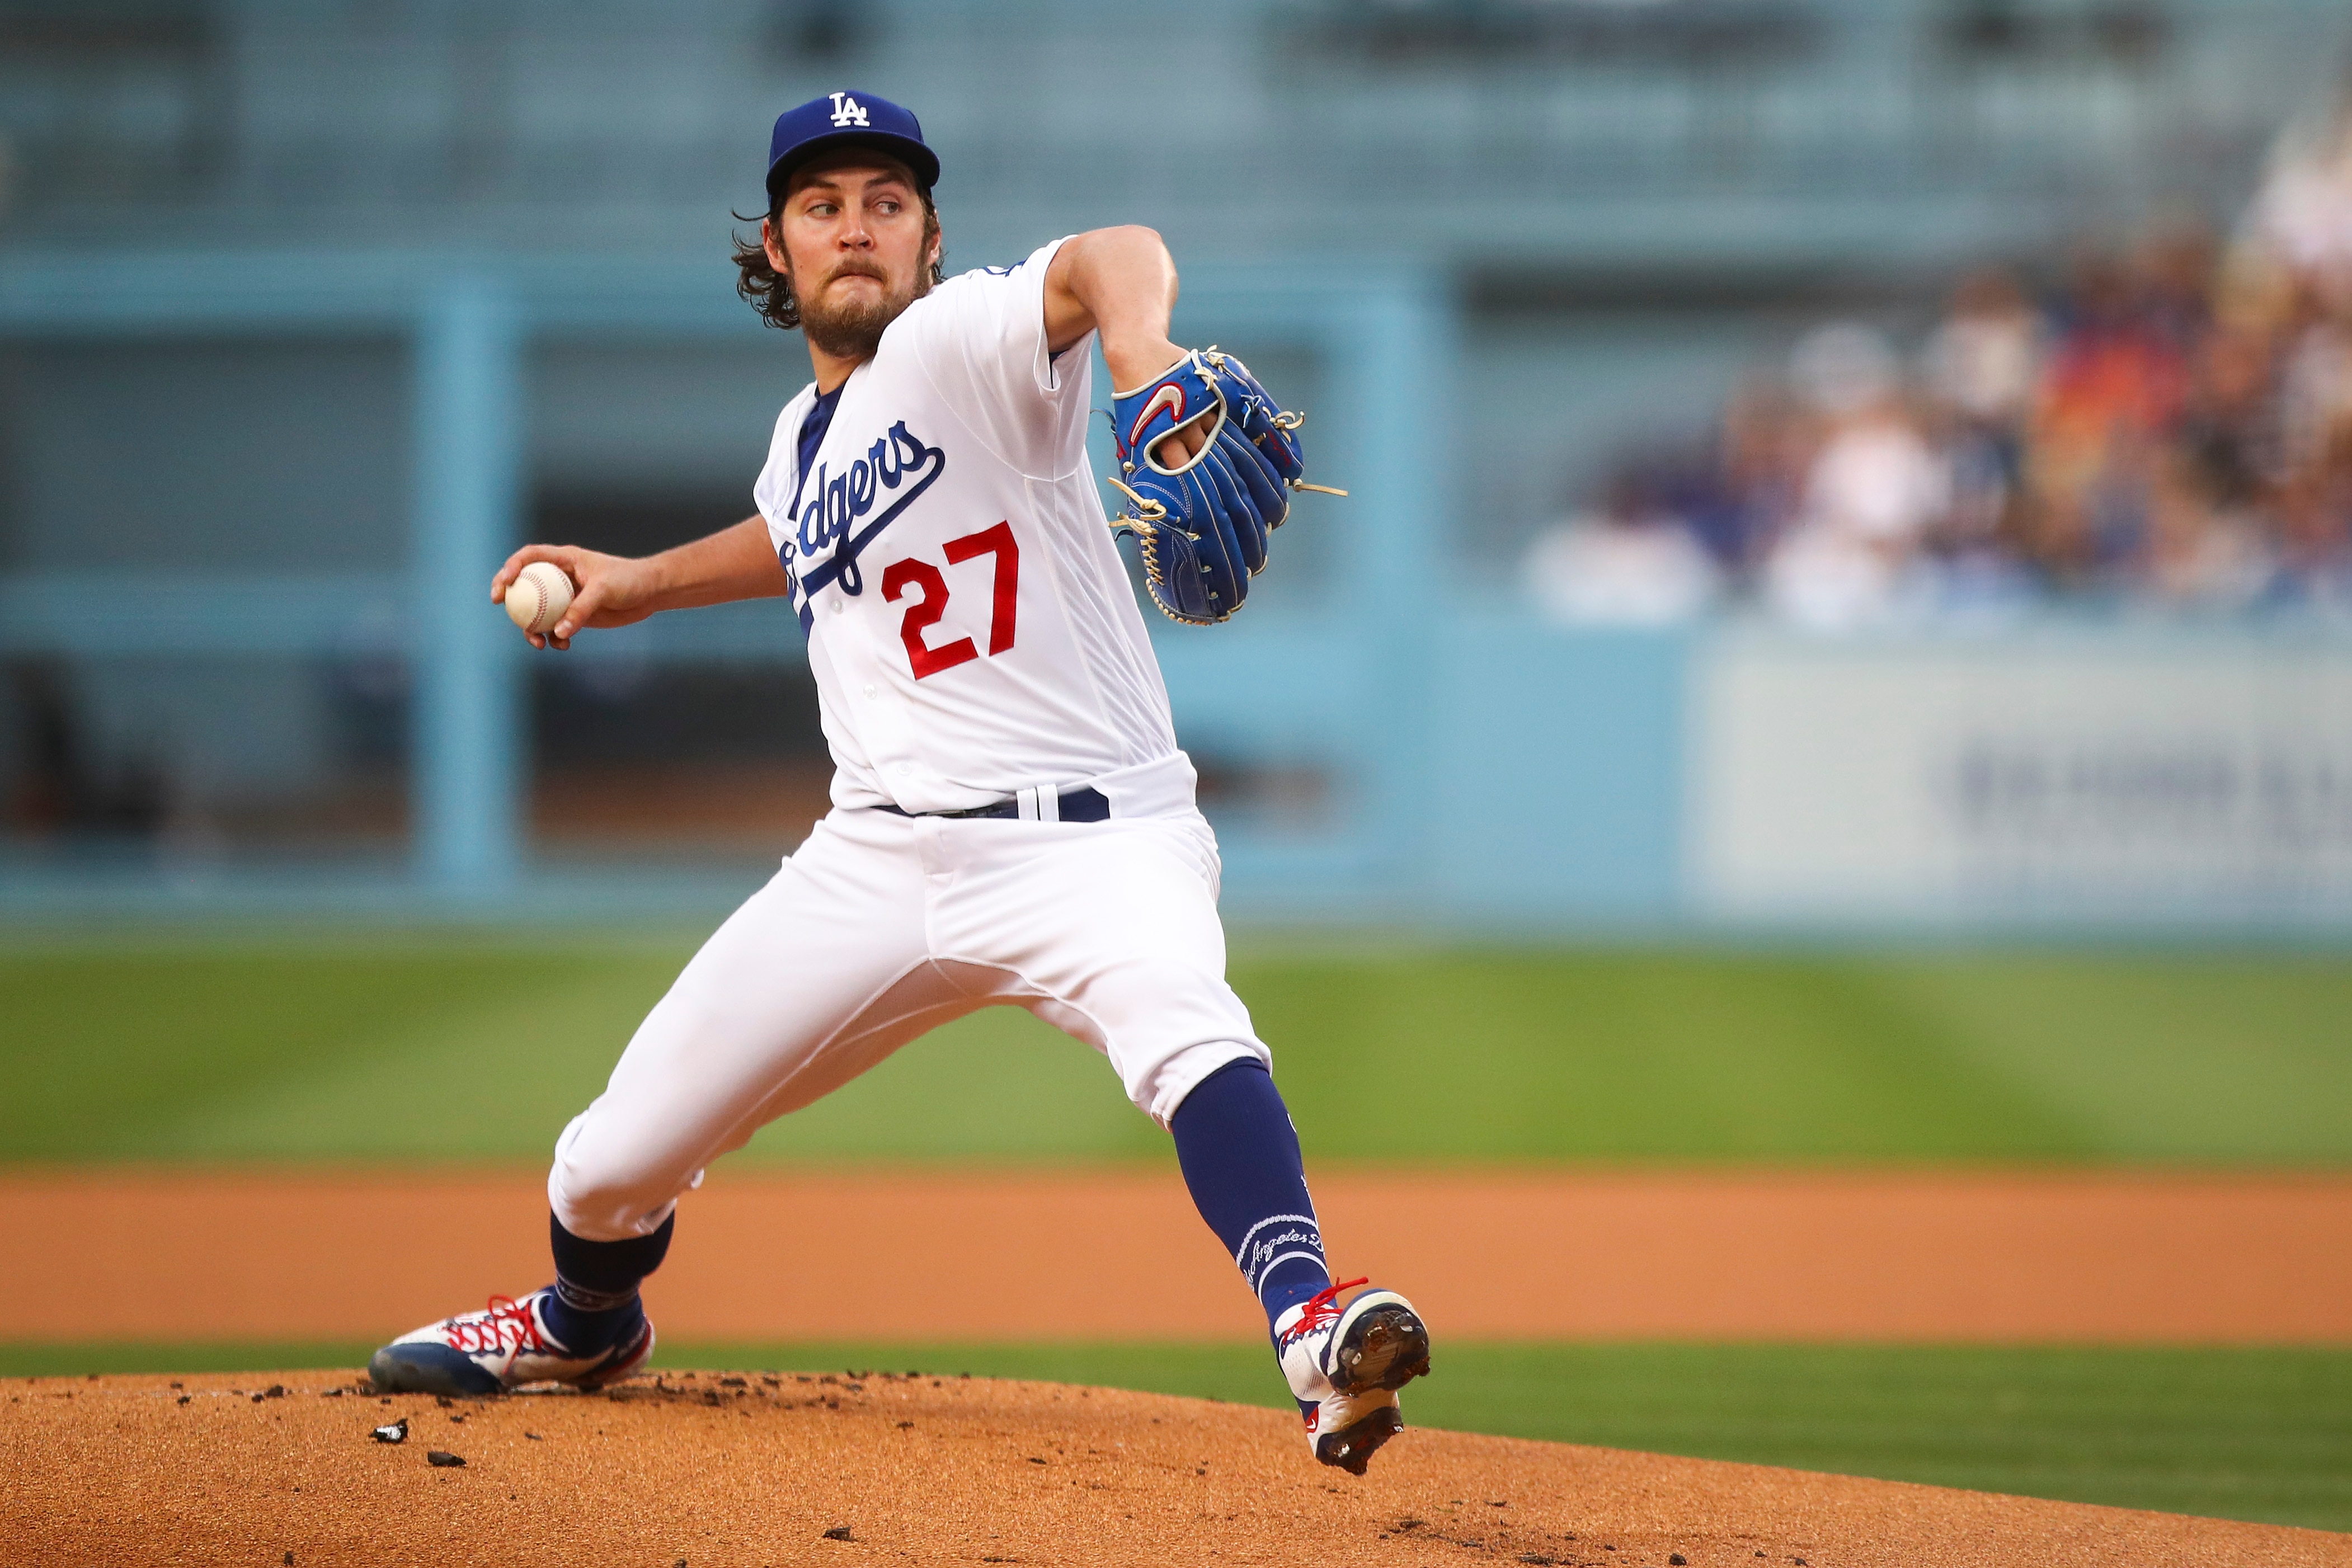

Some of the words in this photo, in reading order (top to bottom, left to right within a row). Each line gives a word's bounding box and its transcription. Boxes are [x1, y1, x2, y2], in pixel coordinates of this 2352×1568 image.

[829, 92, 871, 128] LA
[779, 420, 946, 603] odgers
[881, 519, 1020, 681] 27
